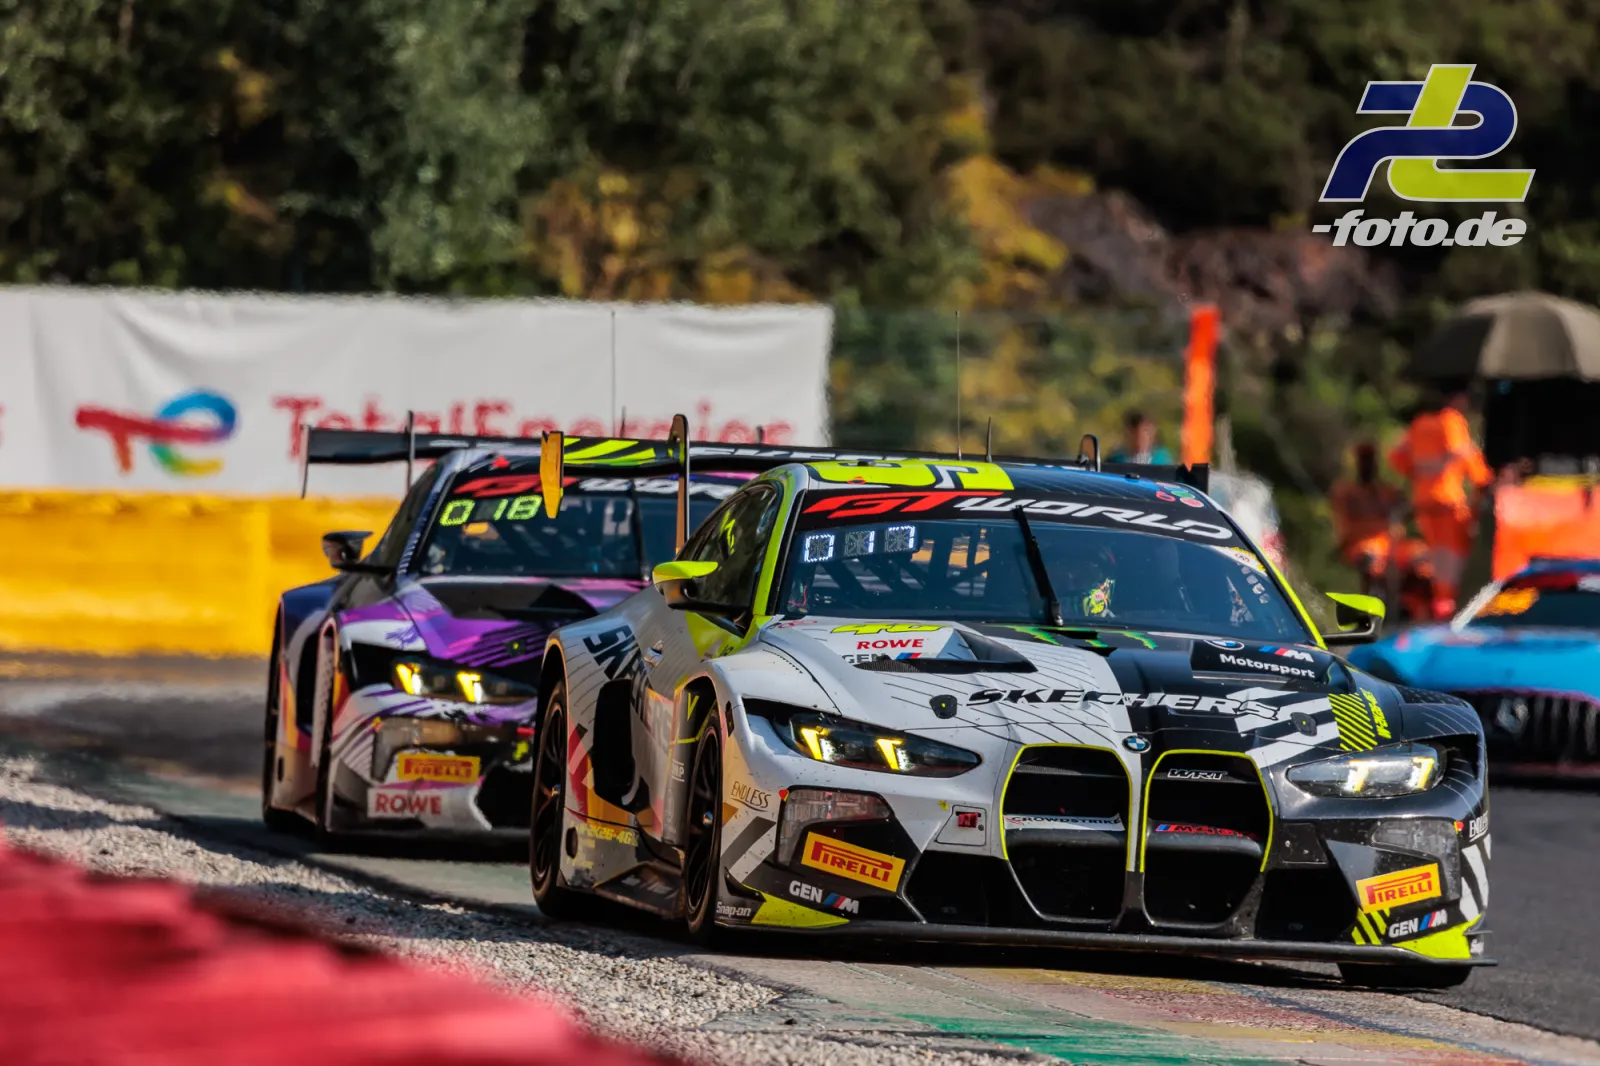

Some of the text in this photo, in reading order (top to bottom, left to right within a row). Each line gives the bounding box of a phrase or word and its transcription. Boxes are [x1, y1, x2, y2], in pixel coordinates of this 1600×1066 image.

[803, 491, 1232, 540] GT WORLD
[856, 638, 925, 650] ROWE
[1219, 653, 1316, 679] Motorsport
[966, 688, 1280, 721] SKECHERS
[374, 793, 442, 815] ROWE
[731, 780, 773, 809] ENDLESS
[1011, 815, 1122, 826] CROWDSTRIKE
[810, 840, 894, 882] PIRELLI
[789, 880, 823, 903] GEN
[1365, 872, 1433, 905] PIRELLI
[716, 901, 752, 917] Snap-on
[1388, 917, 1419, 938] GEN
